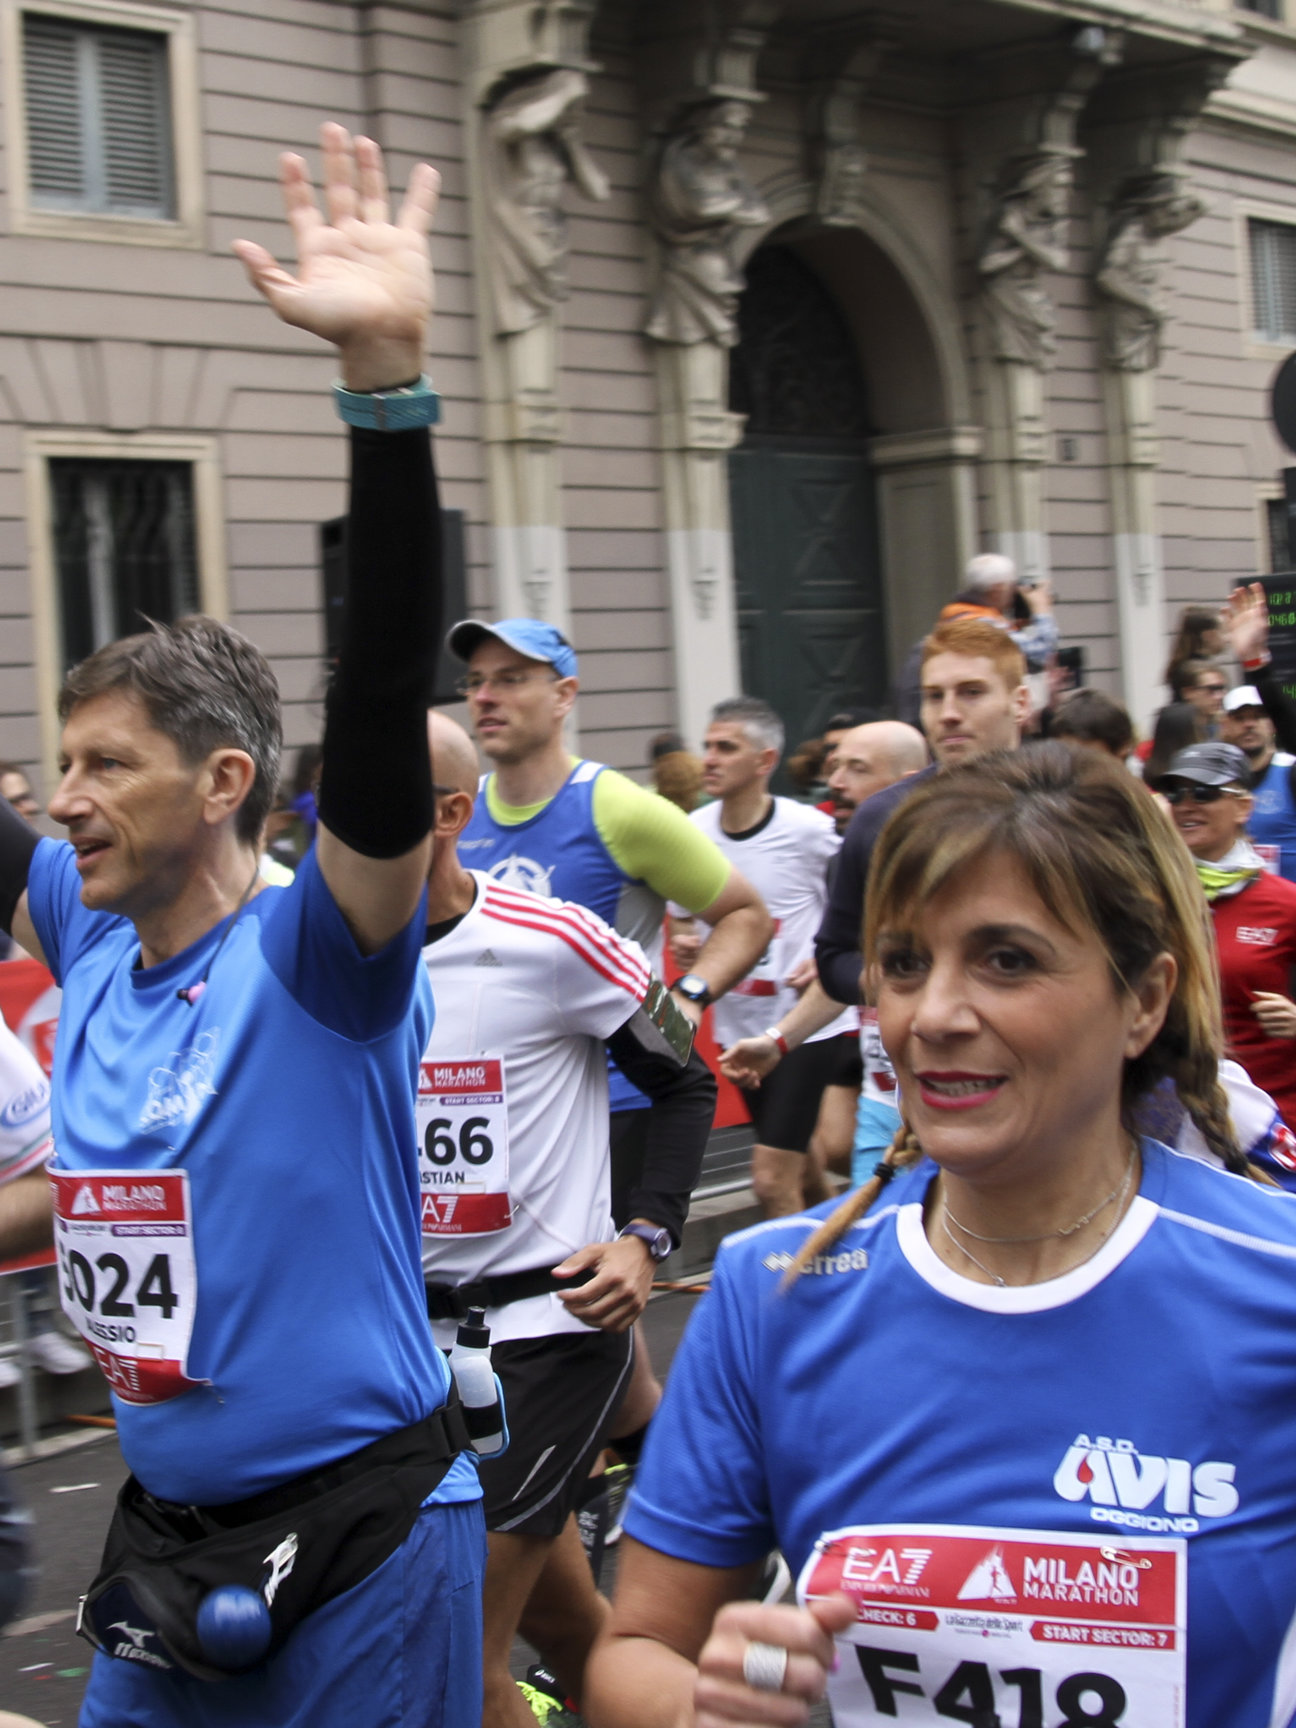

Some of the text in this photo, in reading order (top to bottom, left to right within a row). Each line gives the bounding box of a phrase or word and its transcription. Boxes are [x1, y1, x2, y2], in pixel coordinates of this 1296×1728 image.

[434, 1066, 485, 1080] MILANO
[435, 1077, 486, 1088] MARATHON
[418, 1117, 494, 1166] 66
[420, 1170, 465, 1184] STIAN
[102, 1185, 165, 1201] MILANO
[421, 1195, 458, 1224] A7
[1073, 1434, 1139, 1456] A.S.D.
[1053, 1446, 1240, 1518] AVIS
[1090, 1507, 1200, 1533] OGGIONO
[842, 1547, 933, 1585] EA7
[1023, 1556, 1139, 1590] MILANO
[1022, 1582, 1139, 1607] MARATHON
[906, 1611, 917, 1626] 6
[1042, 1624, 1168, 1647] START SECTOR: 7
[855, 1644, 1127, 1728] F418
